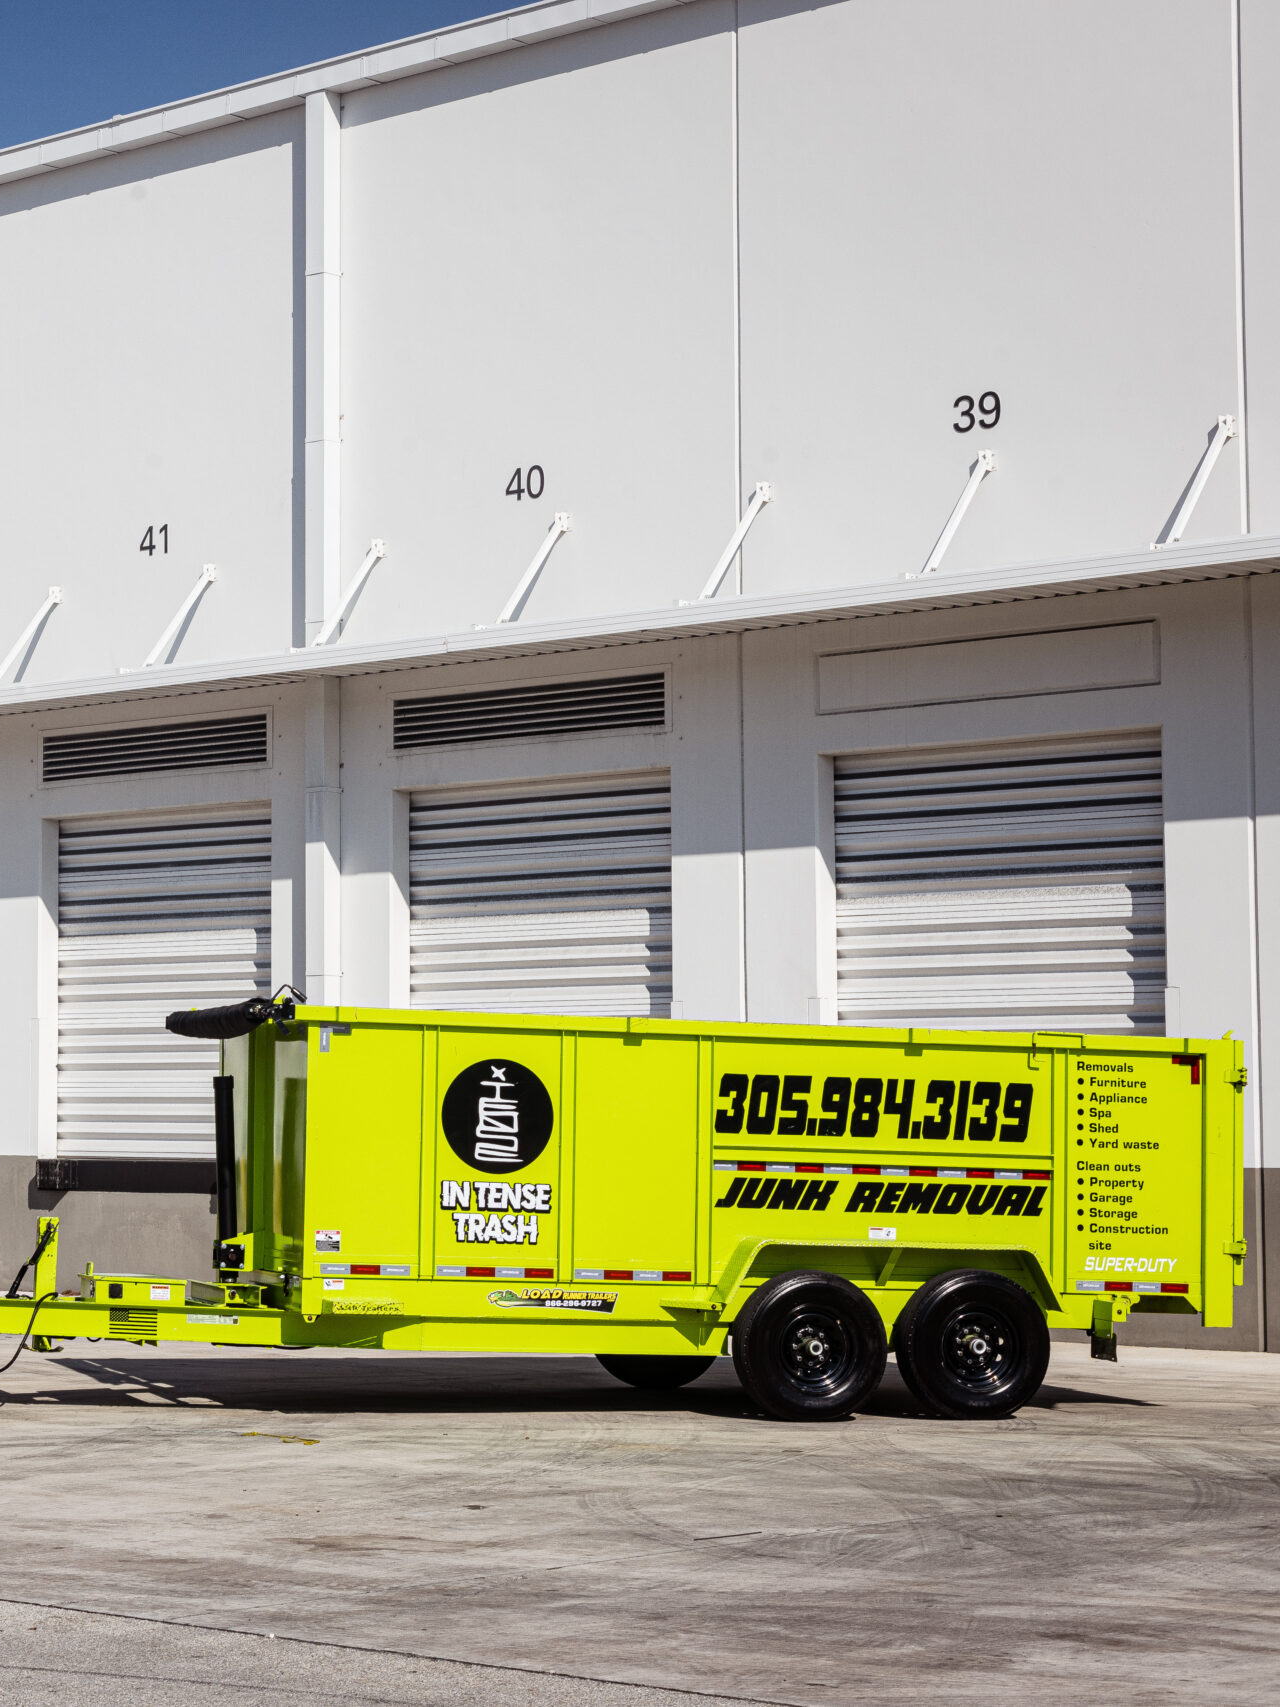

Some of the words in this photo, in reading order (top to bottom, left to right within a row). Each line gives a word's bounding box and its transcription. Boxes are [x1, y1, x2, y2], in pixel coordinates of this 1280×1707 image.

[952, 390, 1001, 434] 39
[505, 464, 545, 501] 40
[139, 523, 169, 557] 41
[1076, 1061, 1134, 1073] Removals
[1089, 1077, 1147, 1089] Furniture
[1089, 1092, 1148, 1105] Appliance
[714, 1073, 1034, 1143] 305.984.3139
[1089, 1107, 1112, 1120] Spa
[1089, 1123, 1119, 1134] Shed
[1089, 1138, 1119, 1149] Yard
[1123, 1140, 1160, 1150] waste
[1076, 1161, 1110, 1171] Clean
[1114, 1163, 1141, 1173] outs
[1089, 1177, 1145, 1191] Property
[441, 1180, 471, 1210] IN
[473, 1181, 551, 1213] TENSE
[714, 1177, 840, 1212] JUNK
[844, 1181, 1048, 1217] REMOVAL
[1089, 1192, 1133, 1206] Garage
[1089, 1207, 1138, 1221] Storage
[453, 1212, 538, 1245] TRASH
[1089, 1223, 1169, 1235] Construction
[1088, 1240, 1112, 1250] site
[1084, 1256, 1178, 1273] SUPER-DUTY
[521, 1289, 563, 1300] LOAD
[562, 1291, 587, 1300] RUNNER
[587, 1292, 617, 1301] TRAILERS
